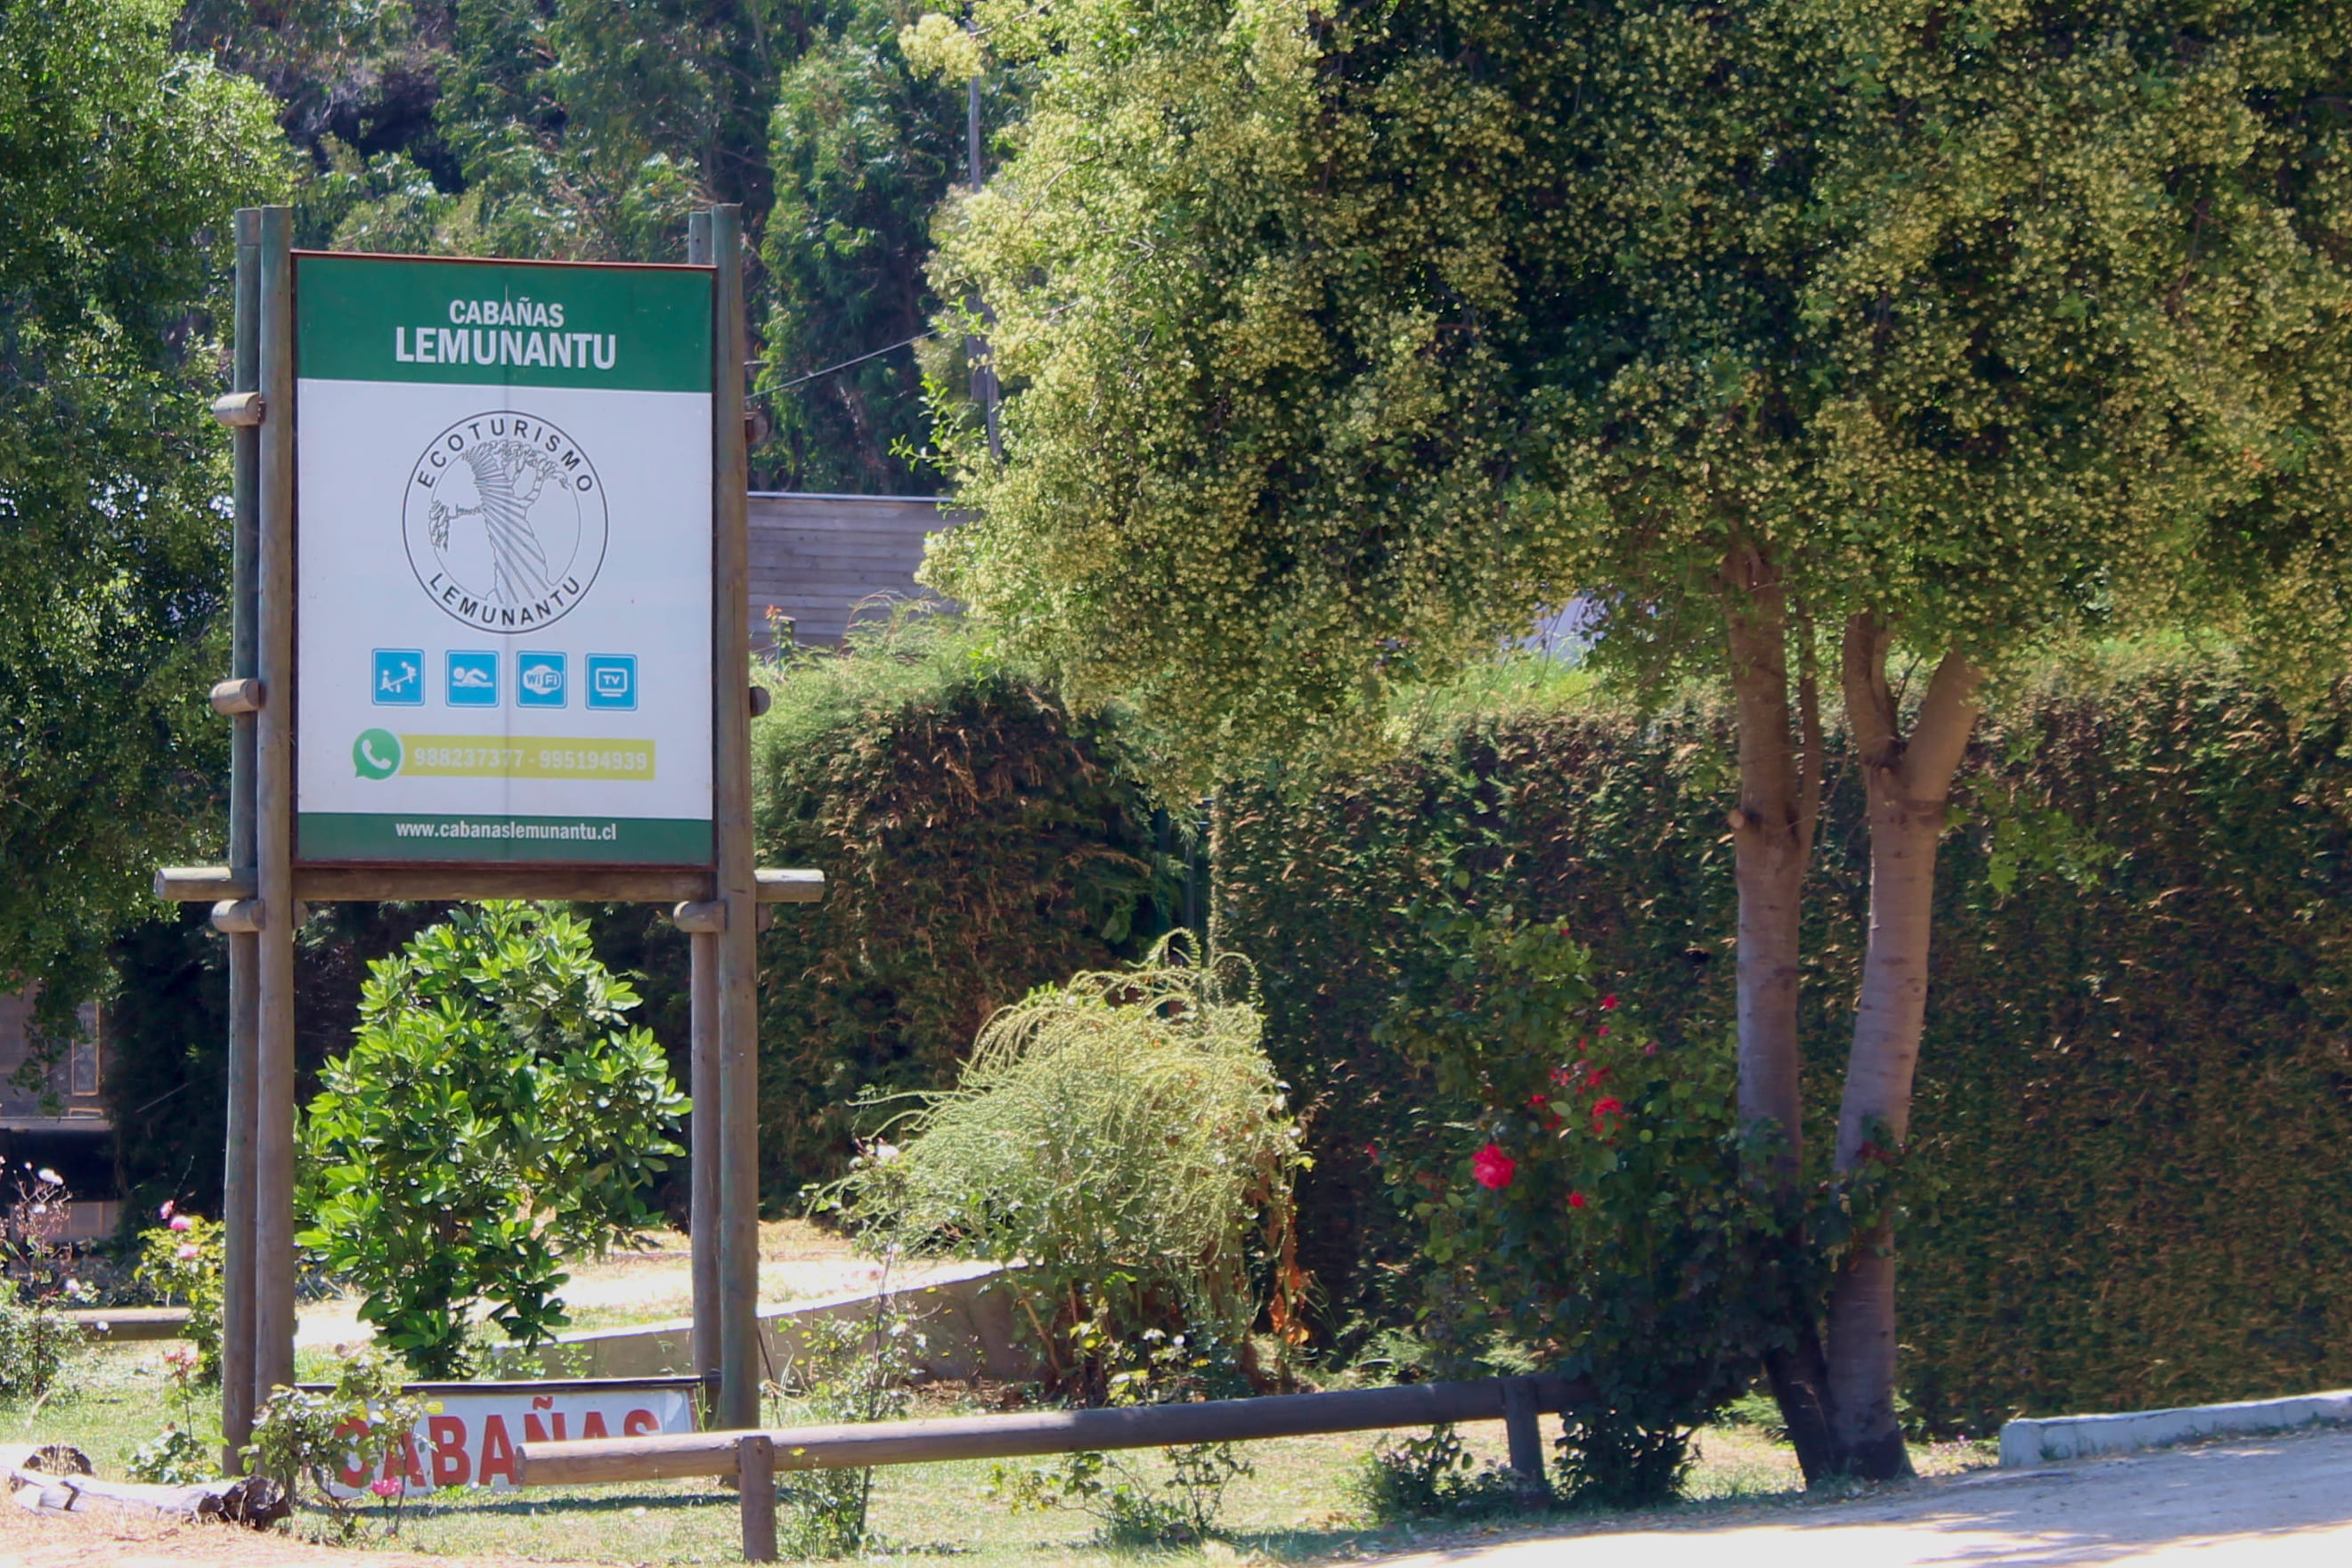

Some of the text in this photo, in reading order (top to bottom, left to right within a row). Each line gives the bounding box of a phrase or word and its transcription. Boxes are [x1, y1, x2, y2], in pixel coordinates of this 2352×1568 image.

[449, 297, 565, 329] CABAÑAS
[395, 327, 616, 370] LEMUNANTU
[418, 418, 593, 494] ECOTURISMO
[429, 573, 582, 626] LEMUNANTU
[603, 675, 621, 686] TV
[413, 747, 525, 768] 988237377
[540, 750, 648, 771] 995194939
[395, 820, 617, 841] www.cabanaslemunantu.cl
